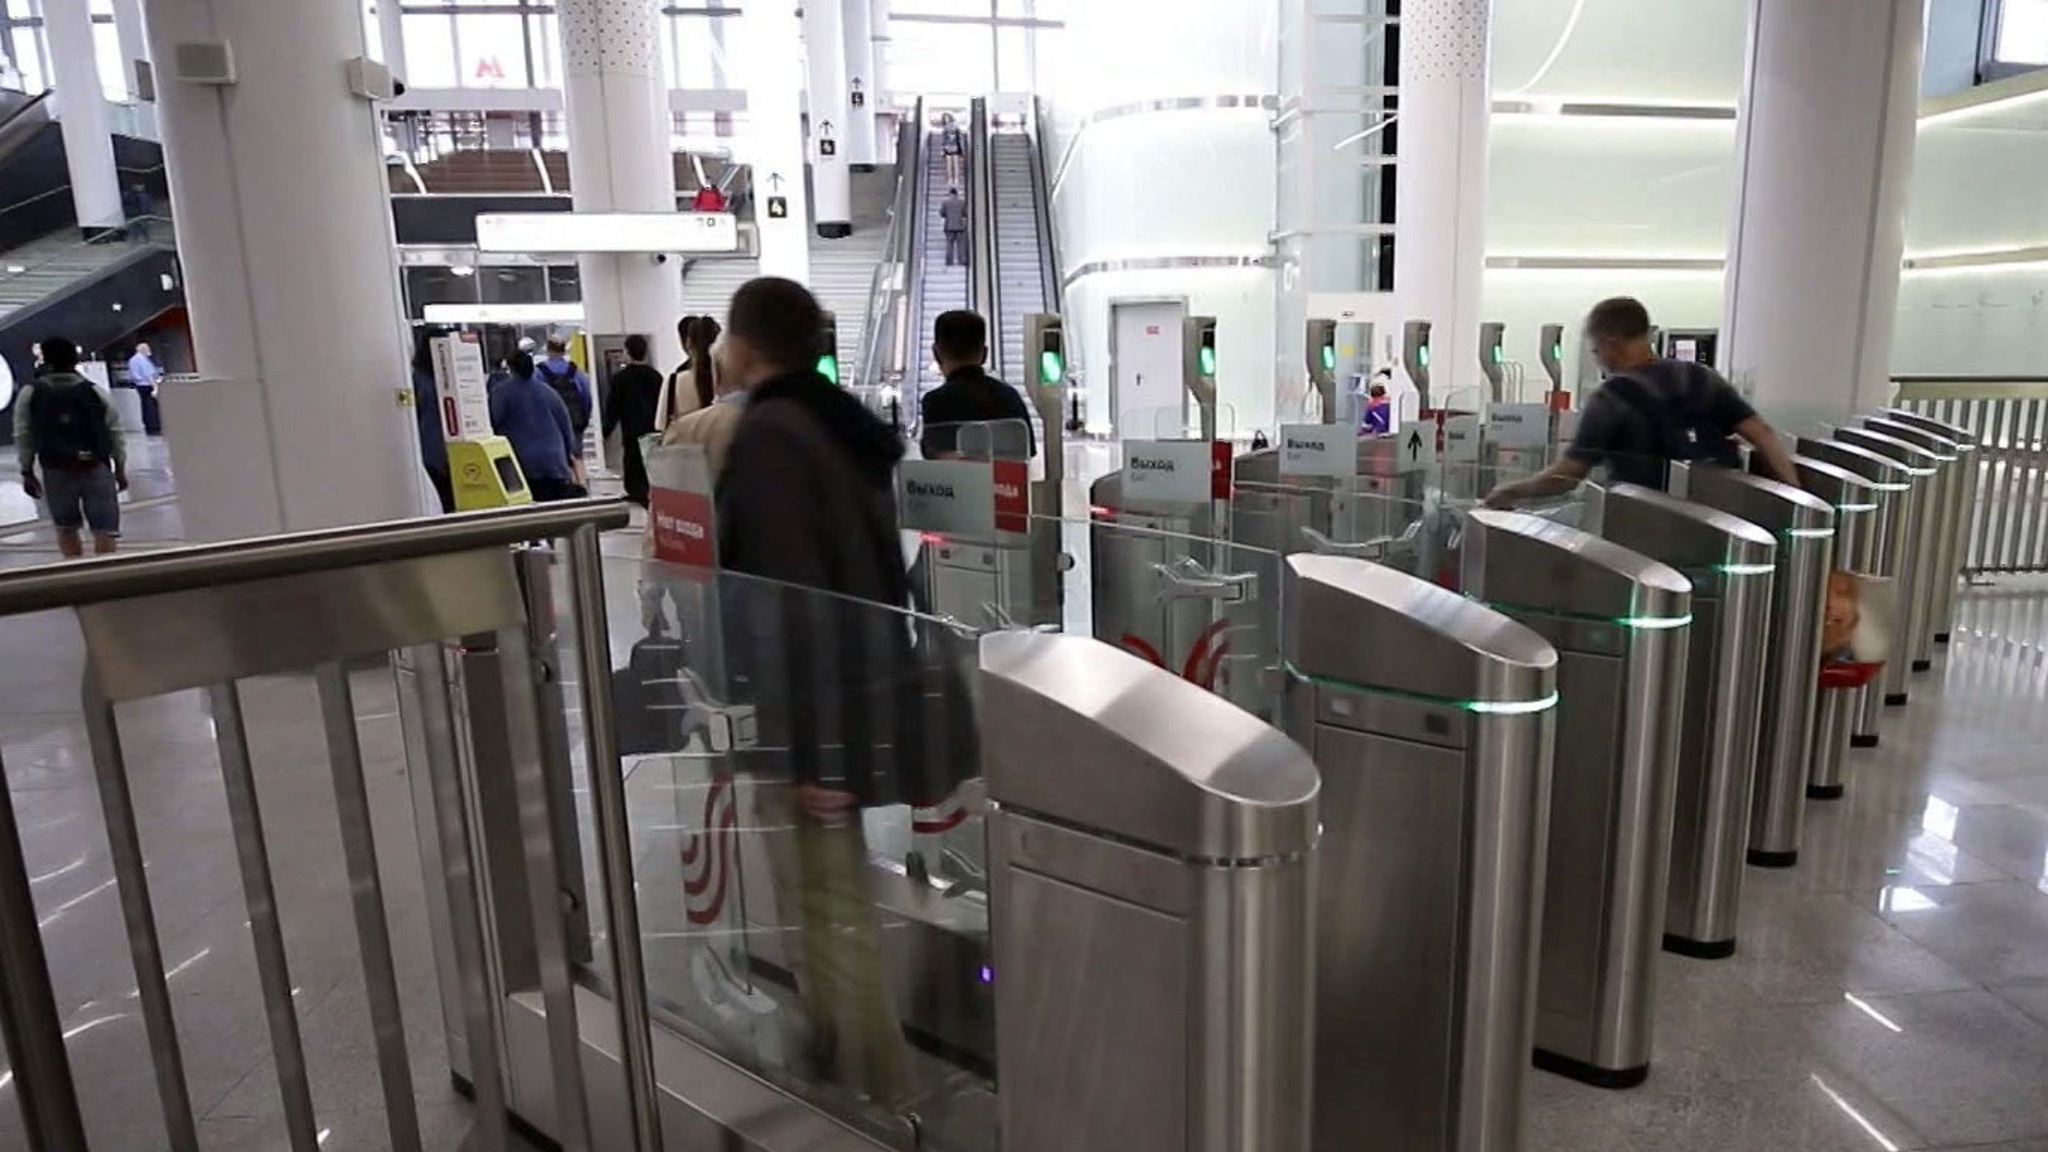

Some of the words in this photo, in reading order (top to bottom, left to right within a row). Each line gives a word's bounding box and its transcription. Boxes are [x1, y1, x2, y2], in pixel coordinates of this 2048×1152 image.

[1287, 438, 1325, 452] Выход
[1131, 457, 1174, 472] Выход
[907, 481, 955, 498] Выход
